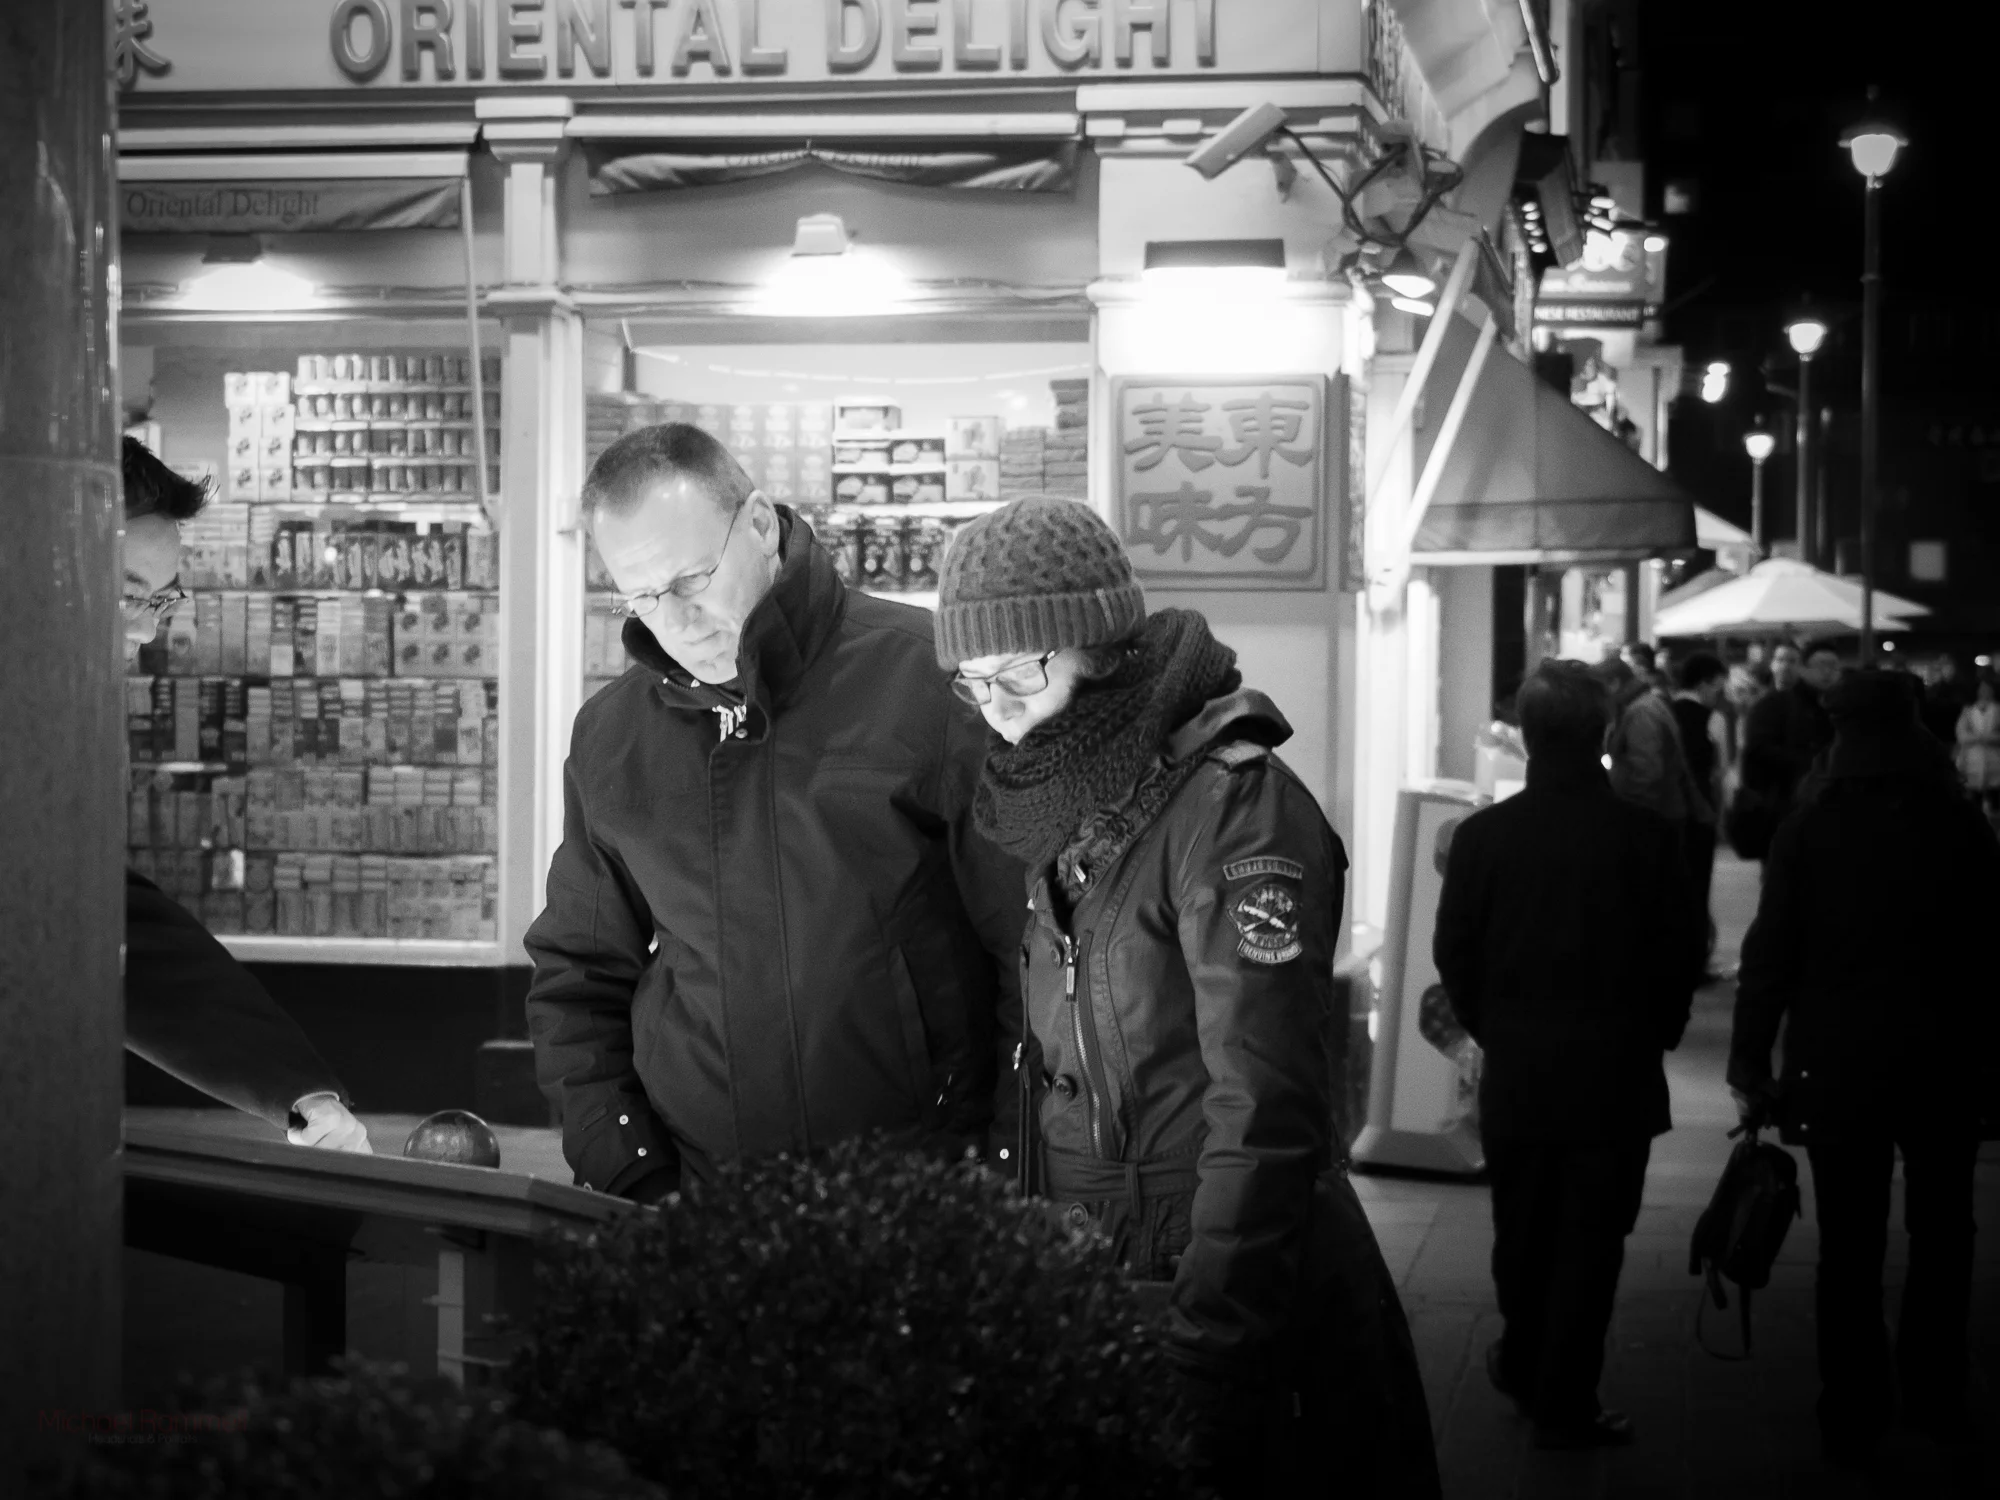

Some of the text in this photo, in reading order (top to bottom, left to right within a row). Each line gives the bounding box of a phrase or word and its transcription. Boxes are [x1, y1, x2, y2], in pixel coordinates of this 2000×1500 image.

[329, 0, 788, 83] ORIENTAL
[127, 190, 319, 225] Oriental Delight
